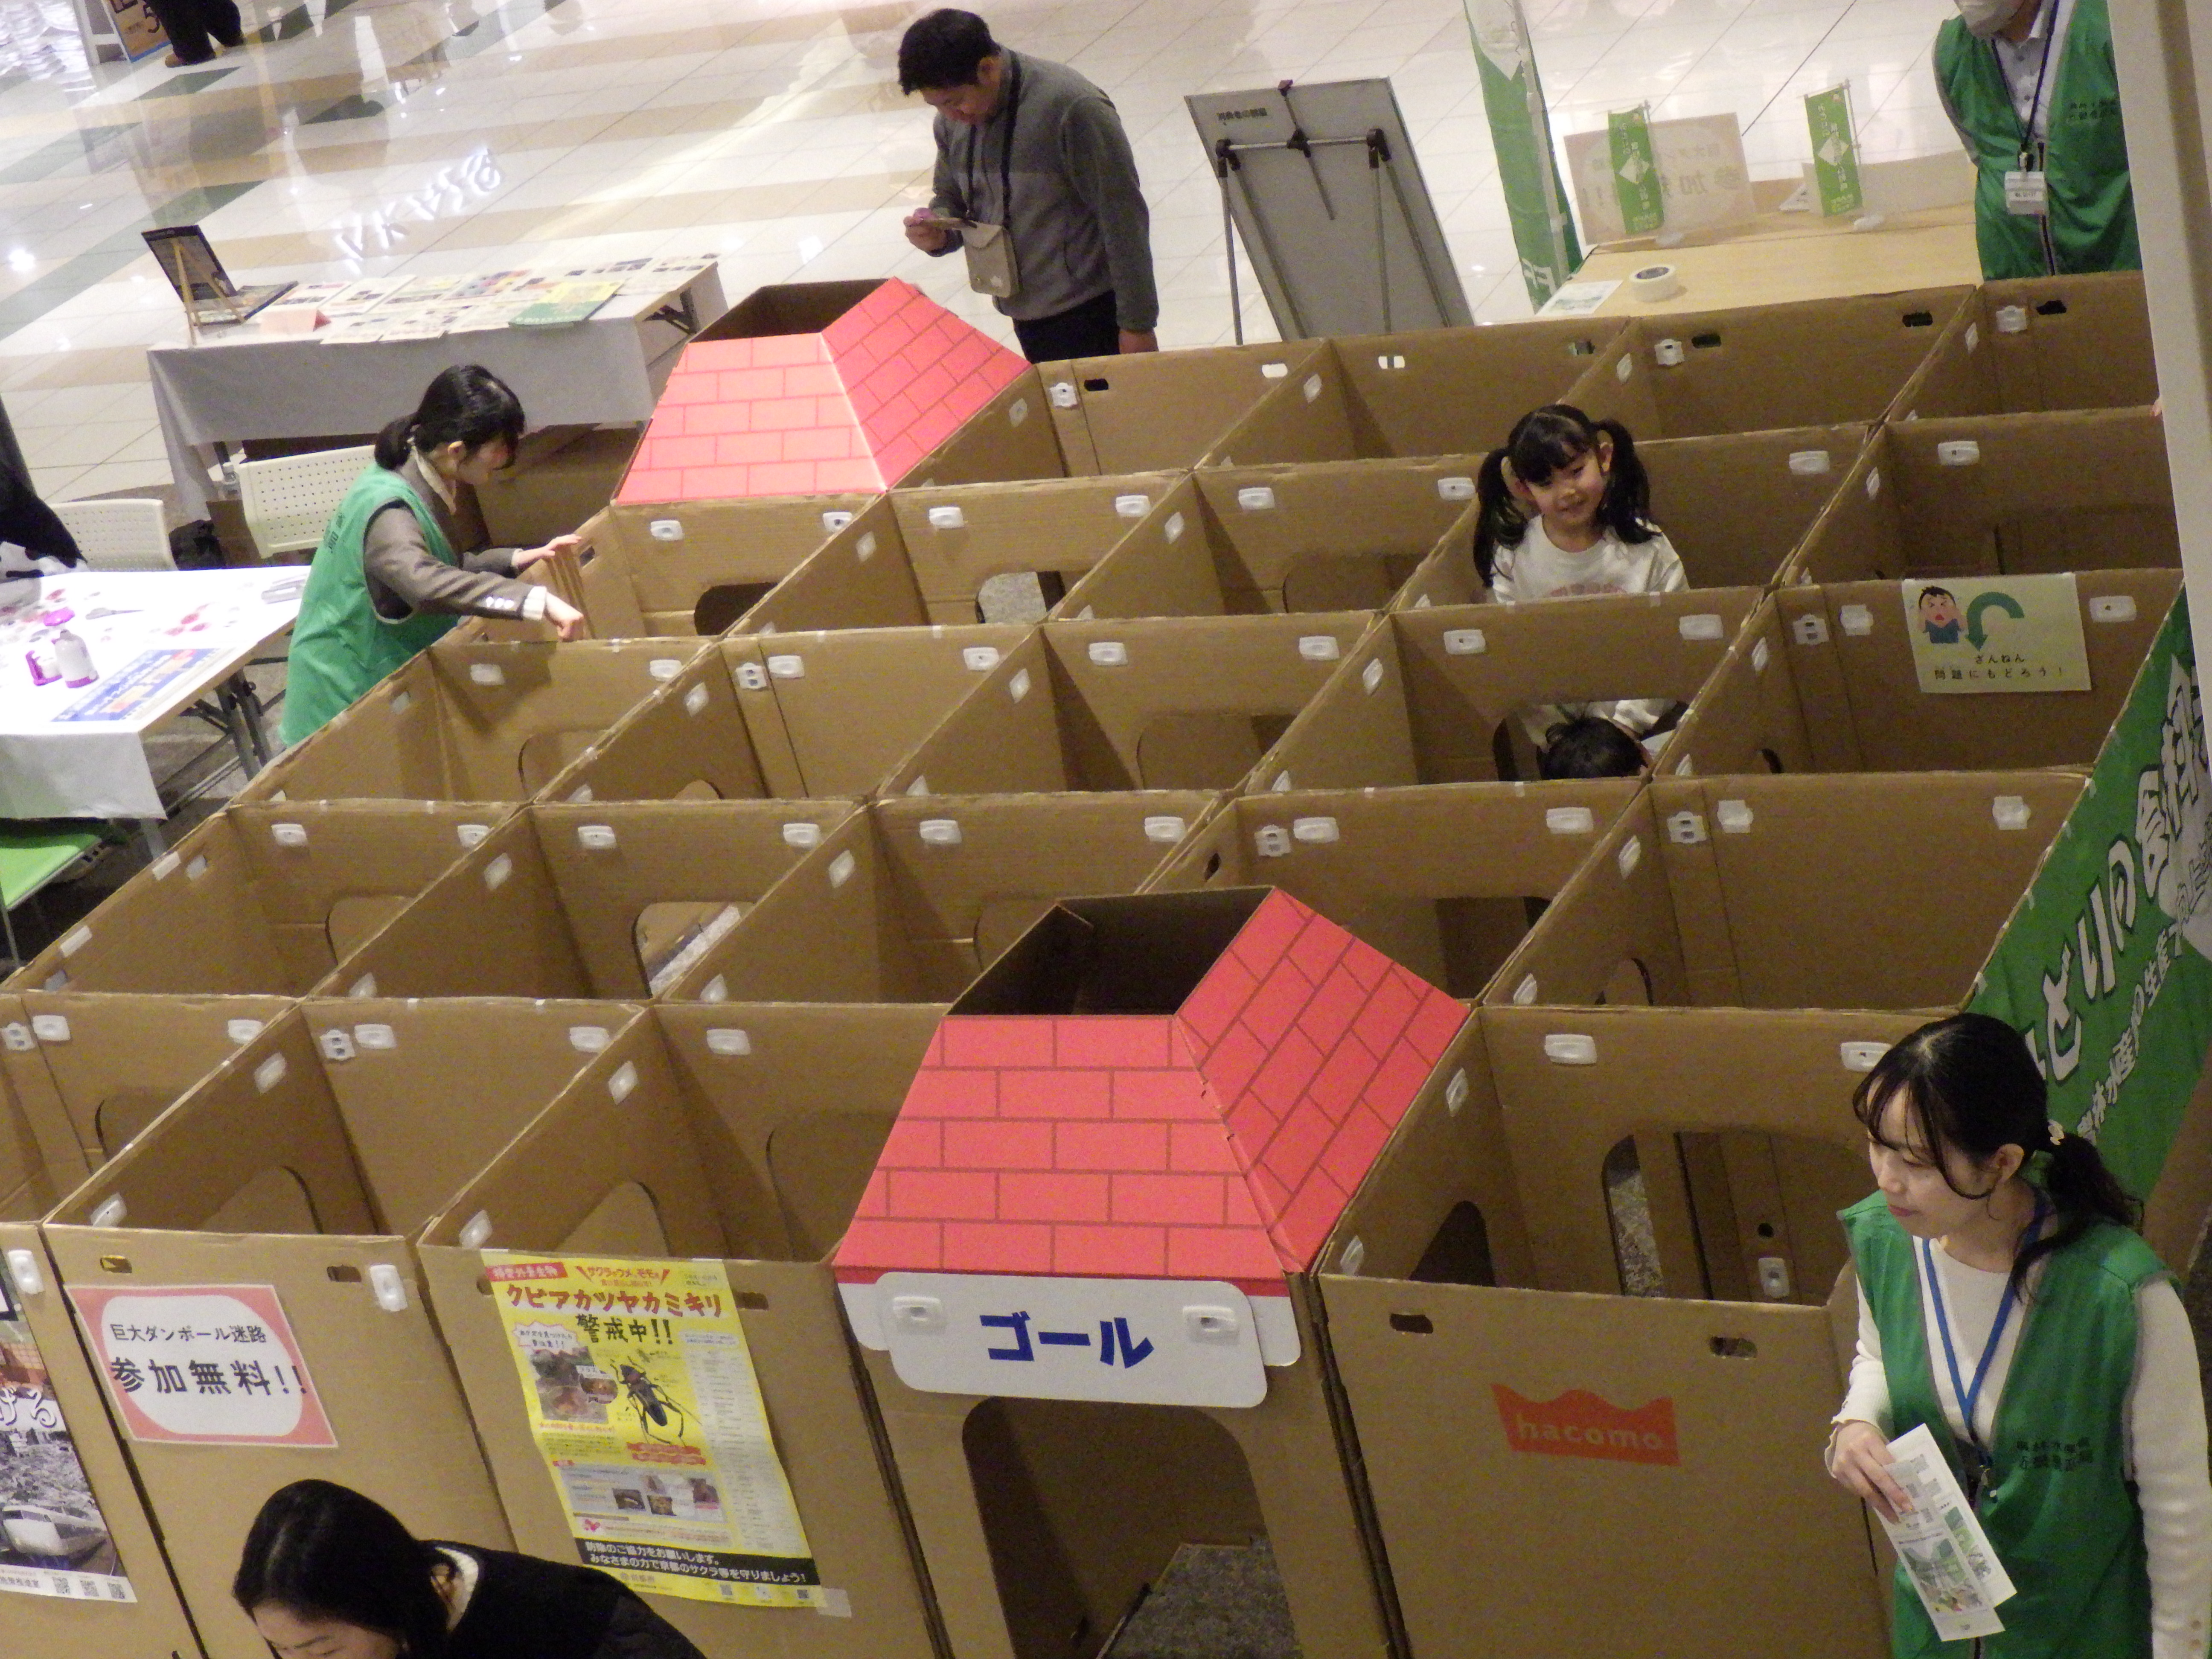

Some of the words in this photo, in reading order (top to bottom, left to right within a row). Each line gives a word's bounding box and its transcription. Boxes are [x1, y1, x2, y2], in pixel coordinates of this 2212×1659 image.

[506, 1284, 722, 1318] クビアカツヤカミキリ
[110, 1324, 267, 1343] 巨大ダンボール迷路
[576, 1313, 673, 1345] 警戒中!!
[980, 1310, 1155, 1369] ゴール
[111, 1356, 307, 1396] 参加無料!!
[1516, 1413, 1663, 1450] hacomo
